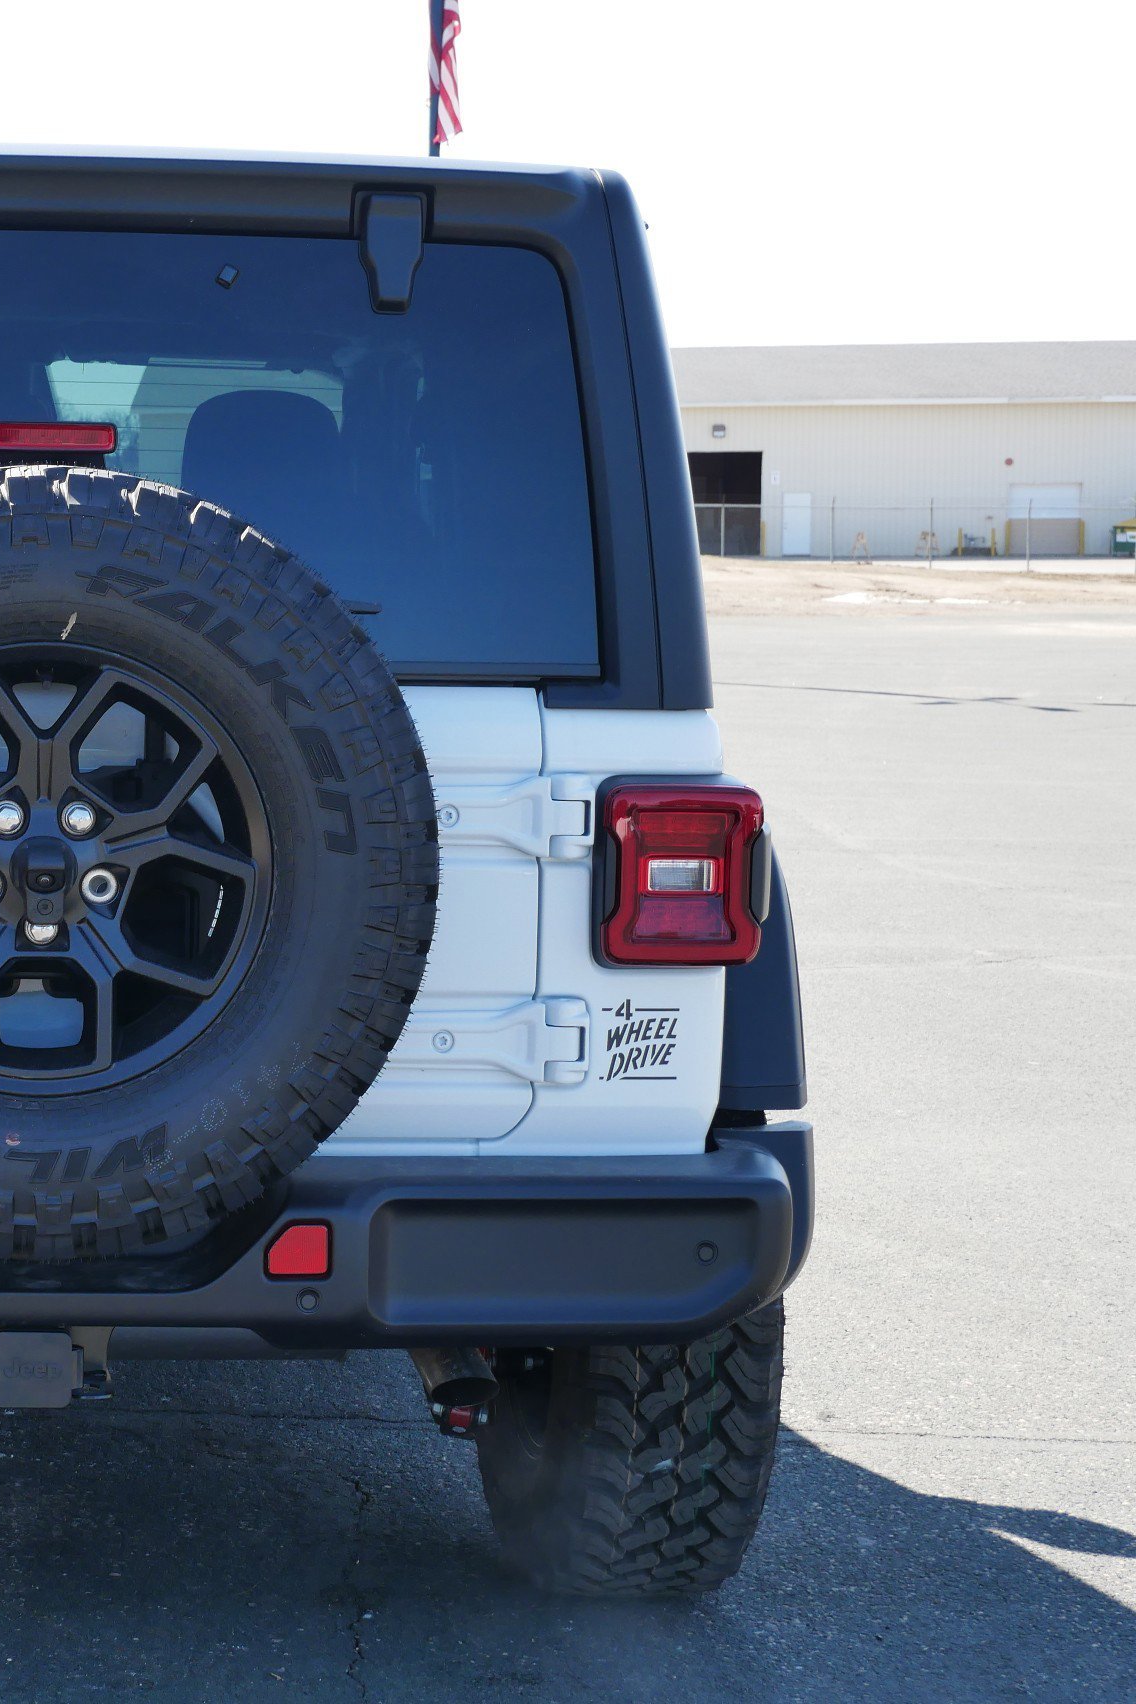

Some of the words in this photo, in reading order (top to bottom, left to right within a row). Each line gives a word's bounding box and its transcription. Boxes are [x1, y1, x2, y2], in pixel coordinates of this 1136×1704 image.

[75, 566, 358, 856] FALKEN
[615, 999, 633, 1020] 4
[606, 1018, 677, 1051] WHEEL
[606, 1043, 676, 1081] DRIVE
